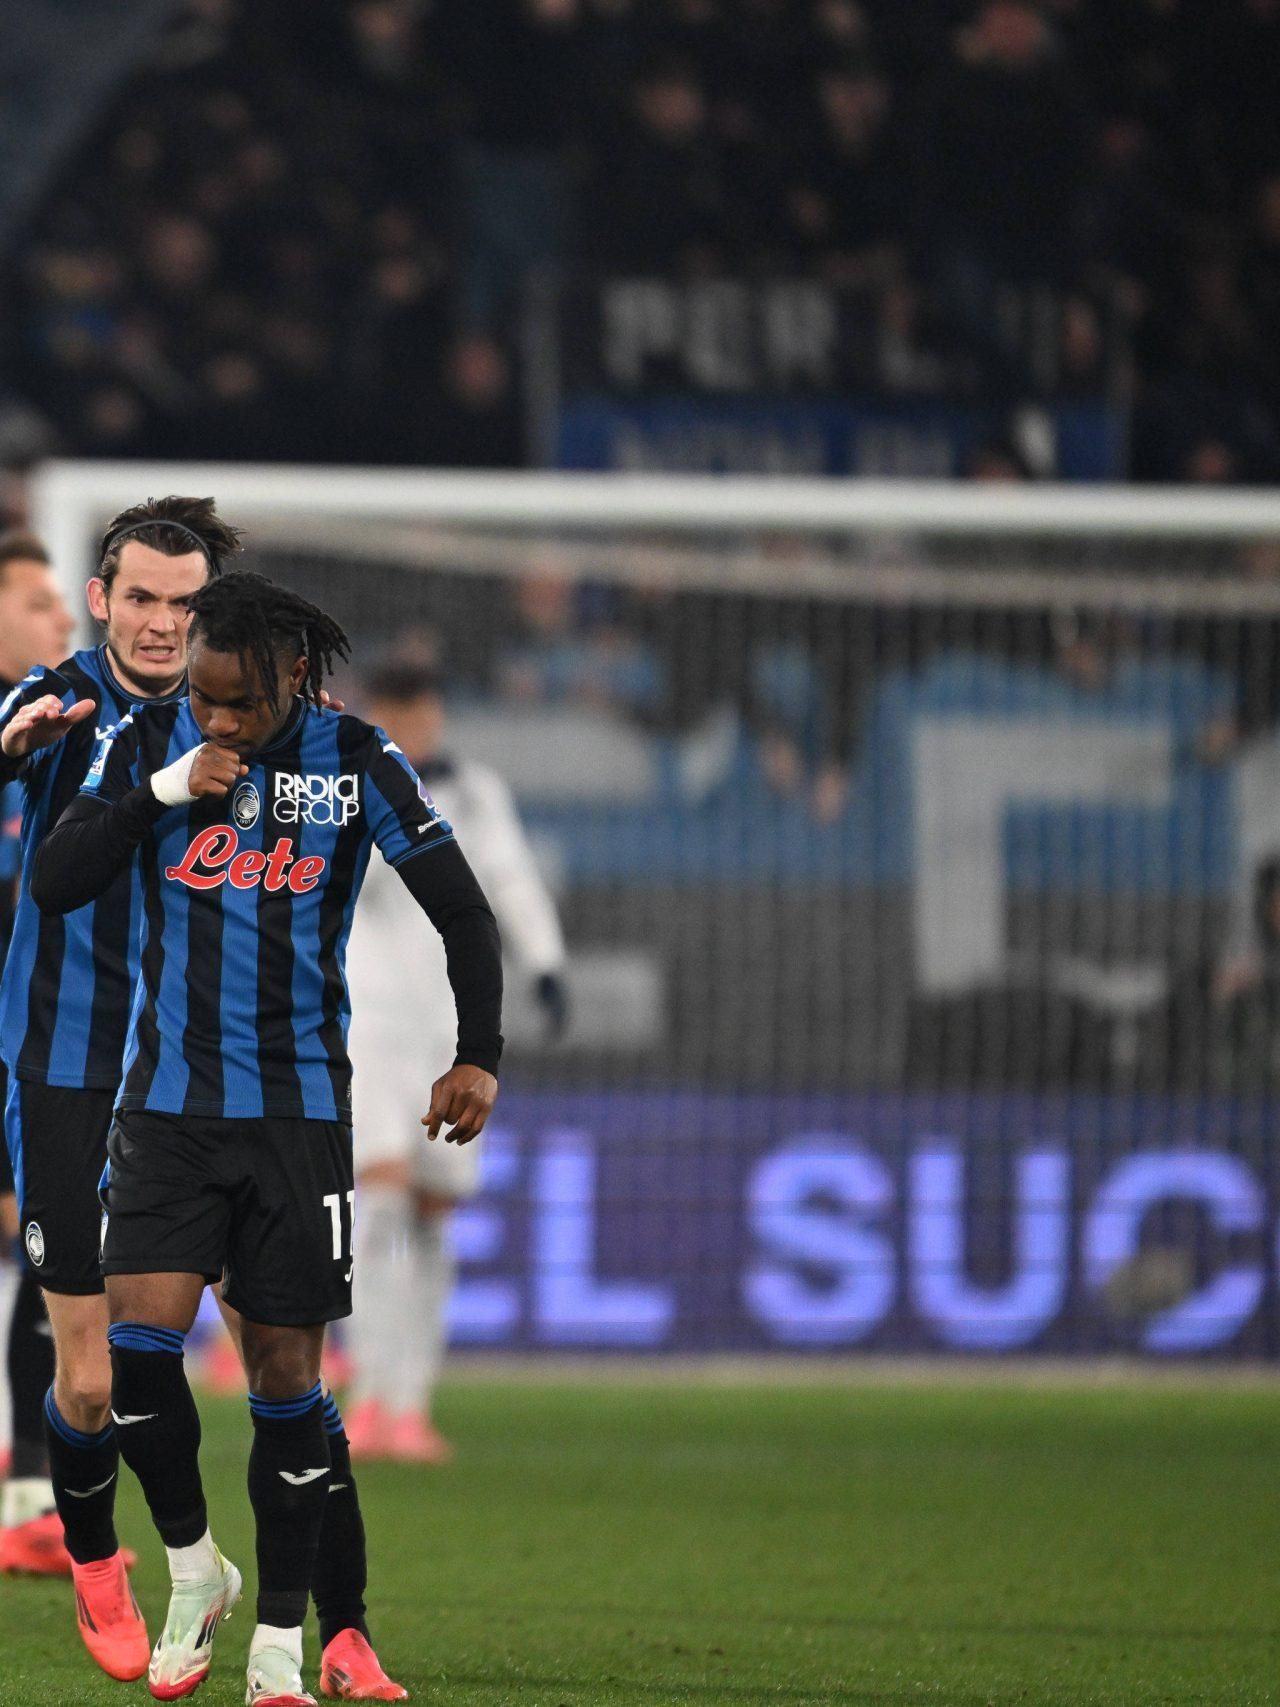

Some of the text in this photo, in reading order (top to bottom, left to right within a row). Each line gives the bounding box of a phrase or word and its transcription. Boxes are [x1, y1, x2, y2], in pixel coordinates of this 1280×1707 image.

[275, 772, 358, 801] RADICI
[273, 797, 359, 826] GROUP
[165, 824, 325, 893] Lete
[742, 1130, 1280, 1350] SUC
